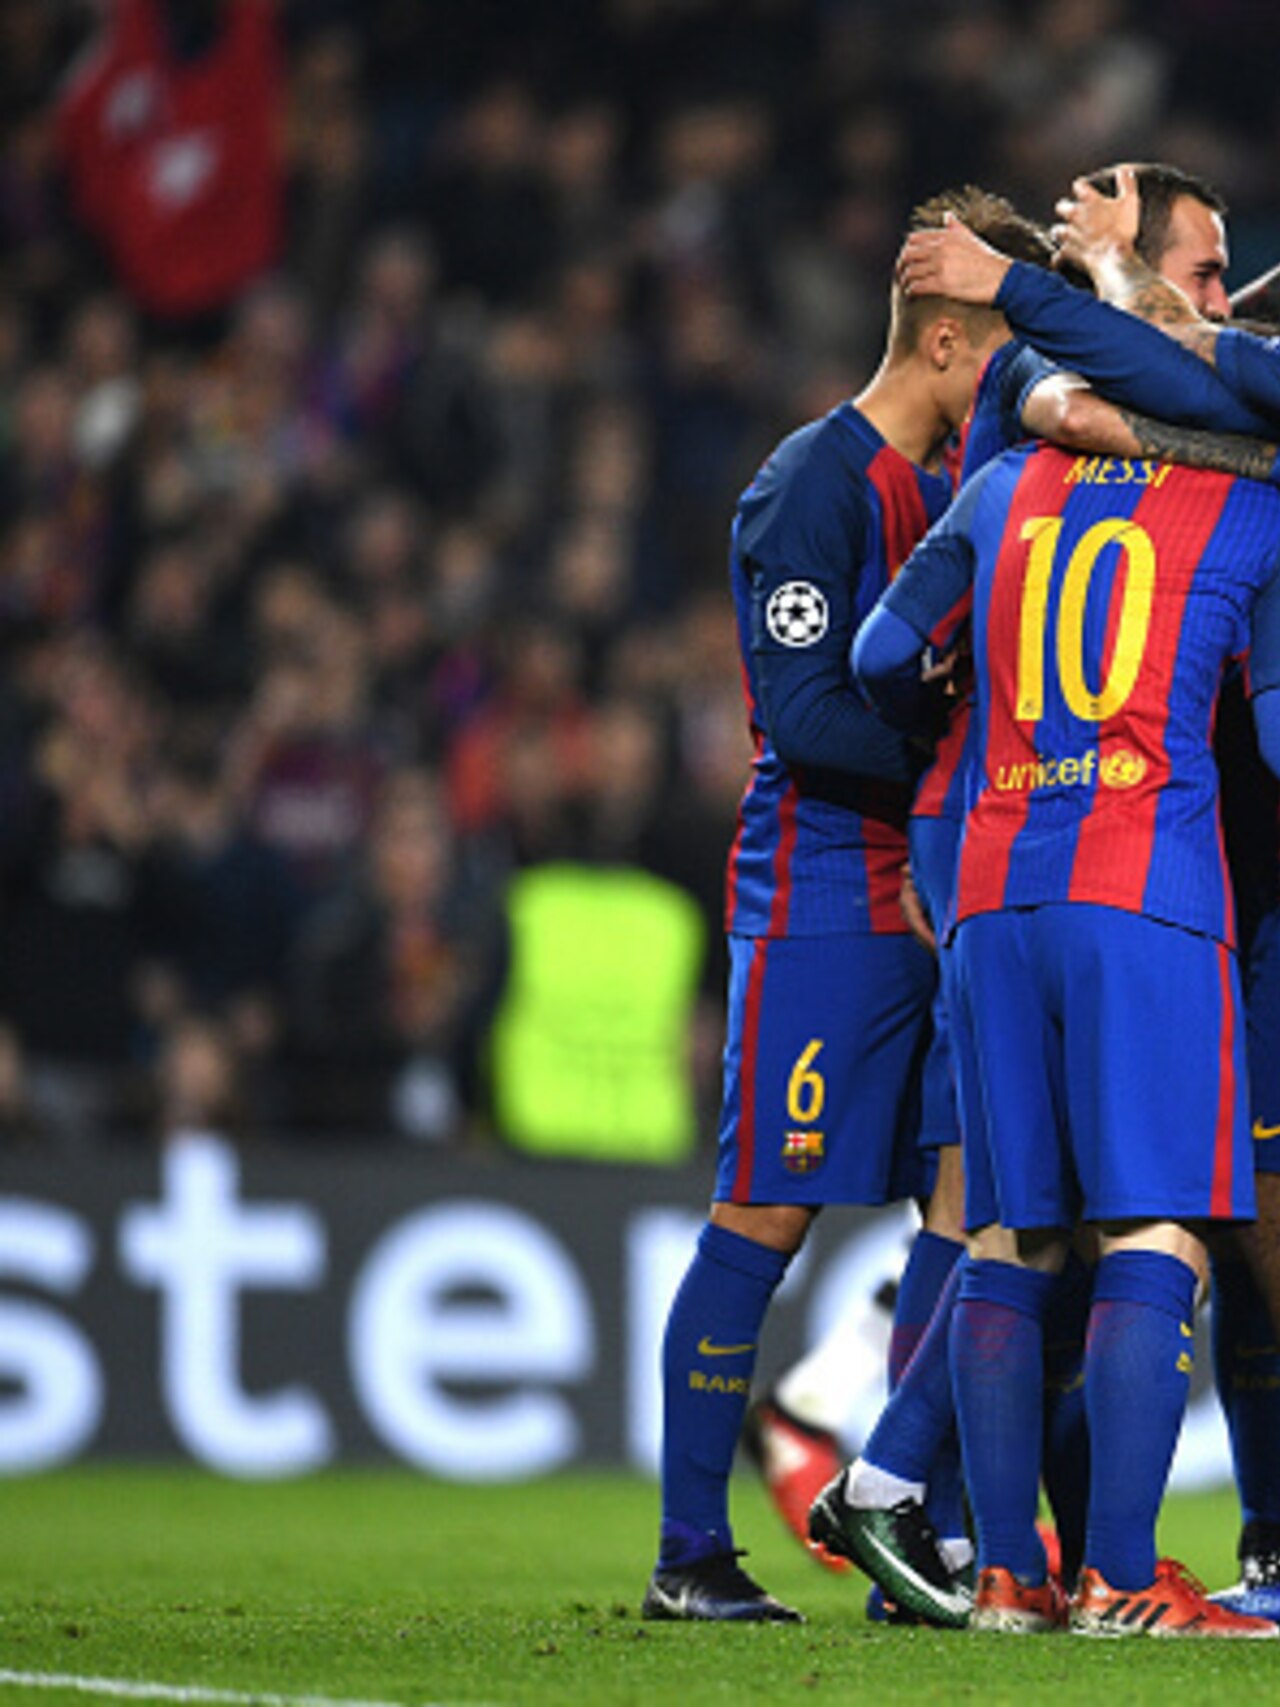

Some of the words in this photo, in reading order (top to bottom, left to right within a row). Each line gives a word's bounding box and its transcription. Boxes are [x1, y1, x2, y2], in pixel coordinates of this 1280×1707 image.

[1062, 455, 1173, 488] MESSI
[1014, 515, 1158, 722] 10
[995, 749, 1099, 791] unicef
[786, 1039, 826, 1123] 6
